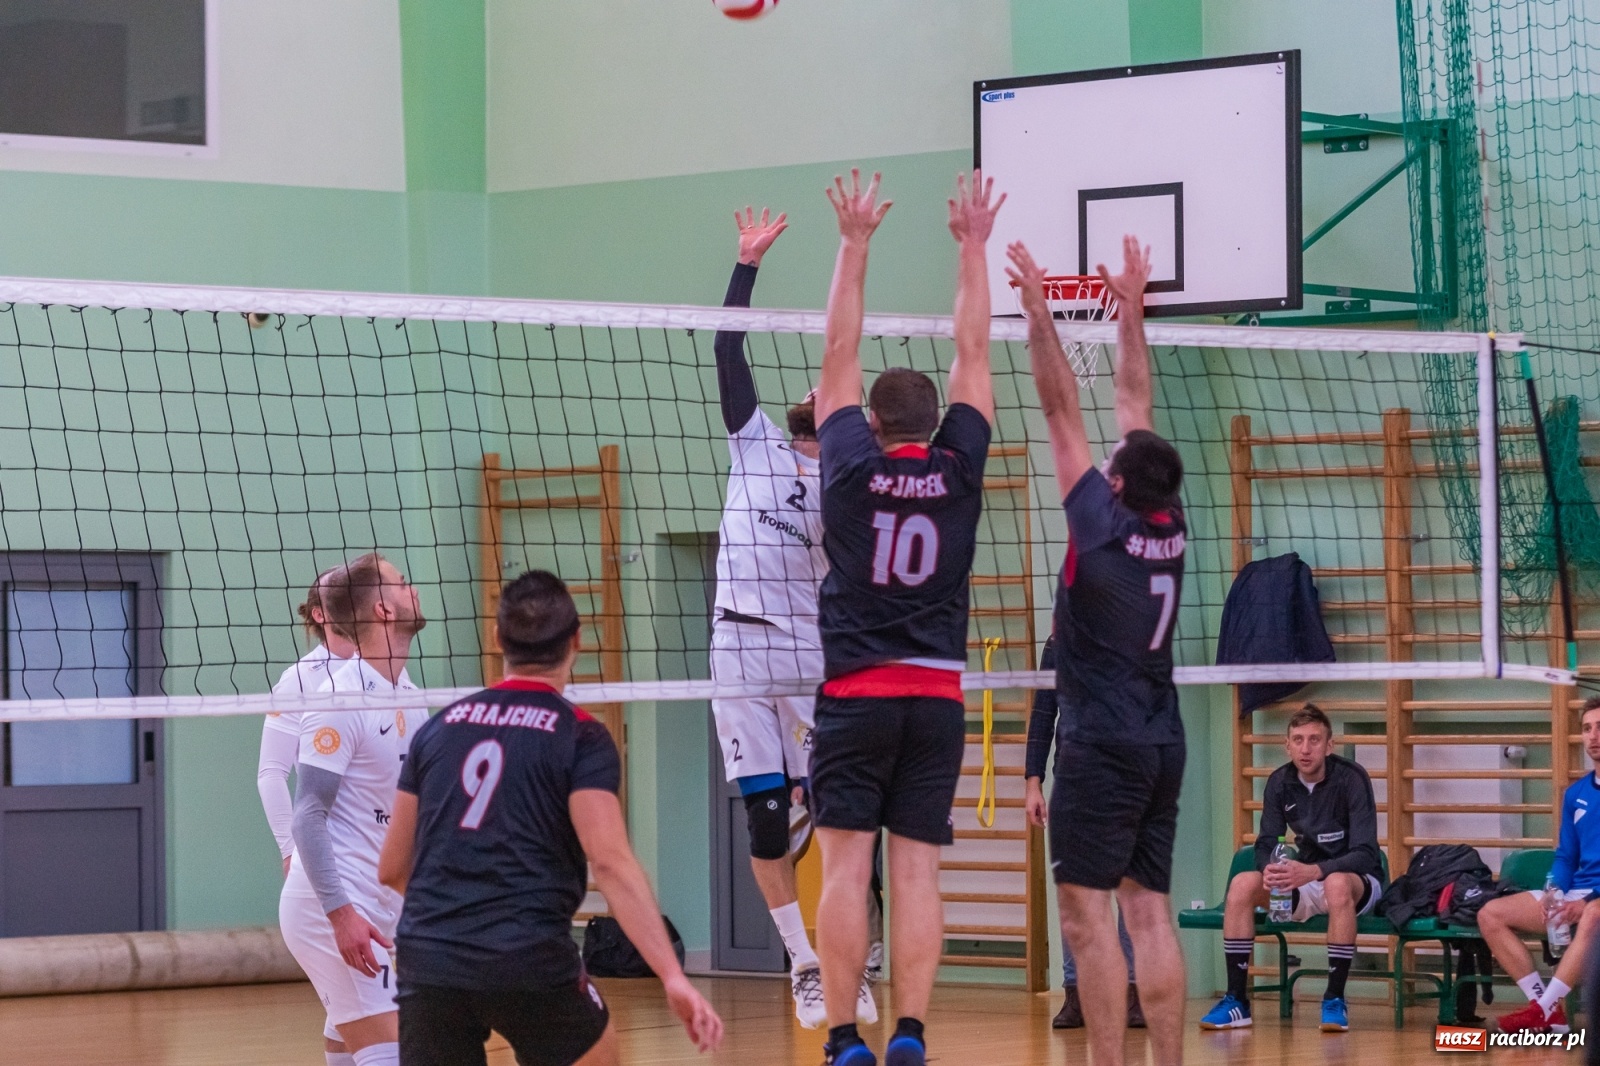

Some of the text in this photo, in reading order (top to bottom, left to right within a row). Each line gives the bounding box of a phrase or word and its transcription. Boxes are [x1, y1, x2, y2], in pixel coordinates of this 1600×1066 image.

[989, 92, 1015, 101] sport plus
[785, 480, 807, 512] 2
[869, 473, 948, 498] #JACEK
[872, 511, 938, 586] 10
[1149, 574, 1176, 651] 7
[444, 703, 559, 732] #RAJCHEL
[731, 737, 743, 763] 2
[461, 738, 504, 830] 9
[379, 964, 389, 989] 7
